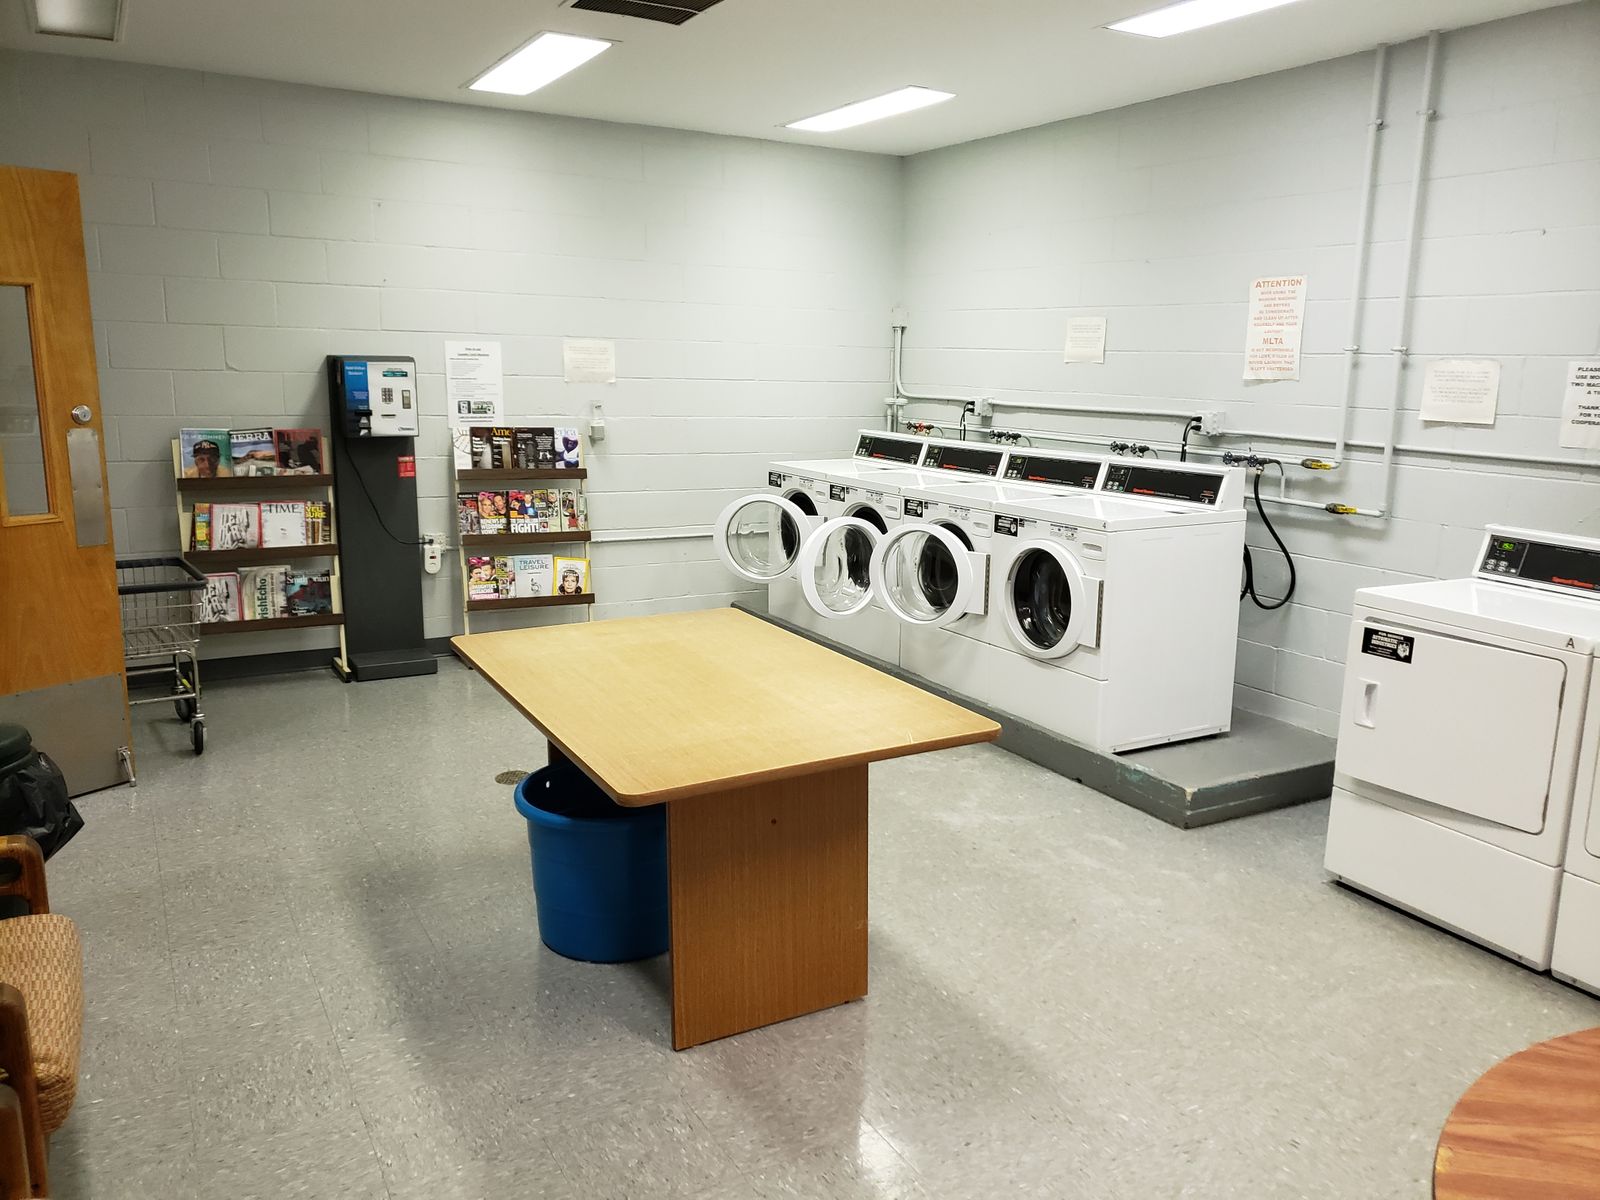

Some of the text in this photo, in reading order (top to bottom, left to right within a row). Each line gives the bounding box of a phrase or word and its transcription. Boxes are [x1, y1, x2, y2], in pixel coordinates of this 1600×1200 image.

[1255, 279, 1303, 289] ATTENTION
[1262, 337, 1284, 345] MLTA
[267, 503, 302, 514] TIME
[510, 522, 539, 534] FIGHT!
[1565, 637, 1575, 649] A
